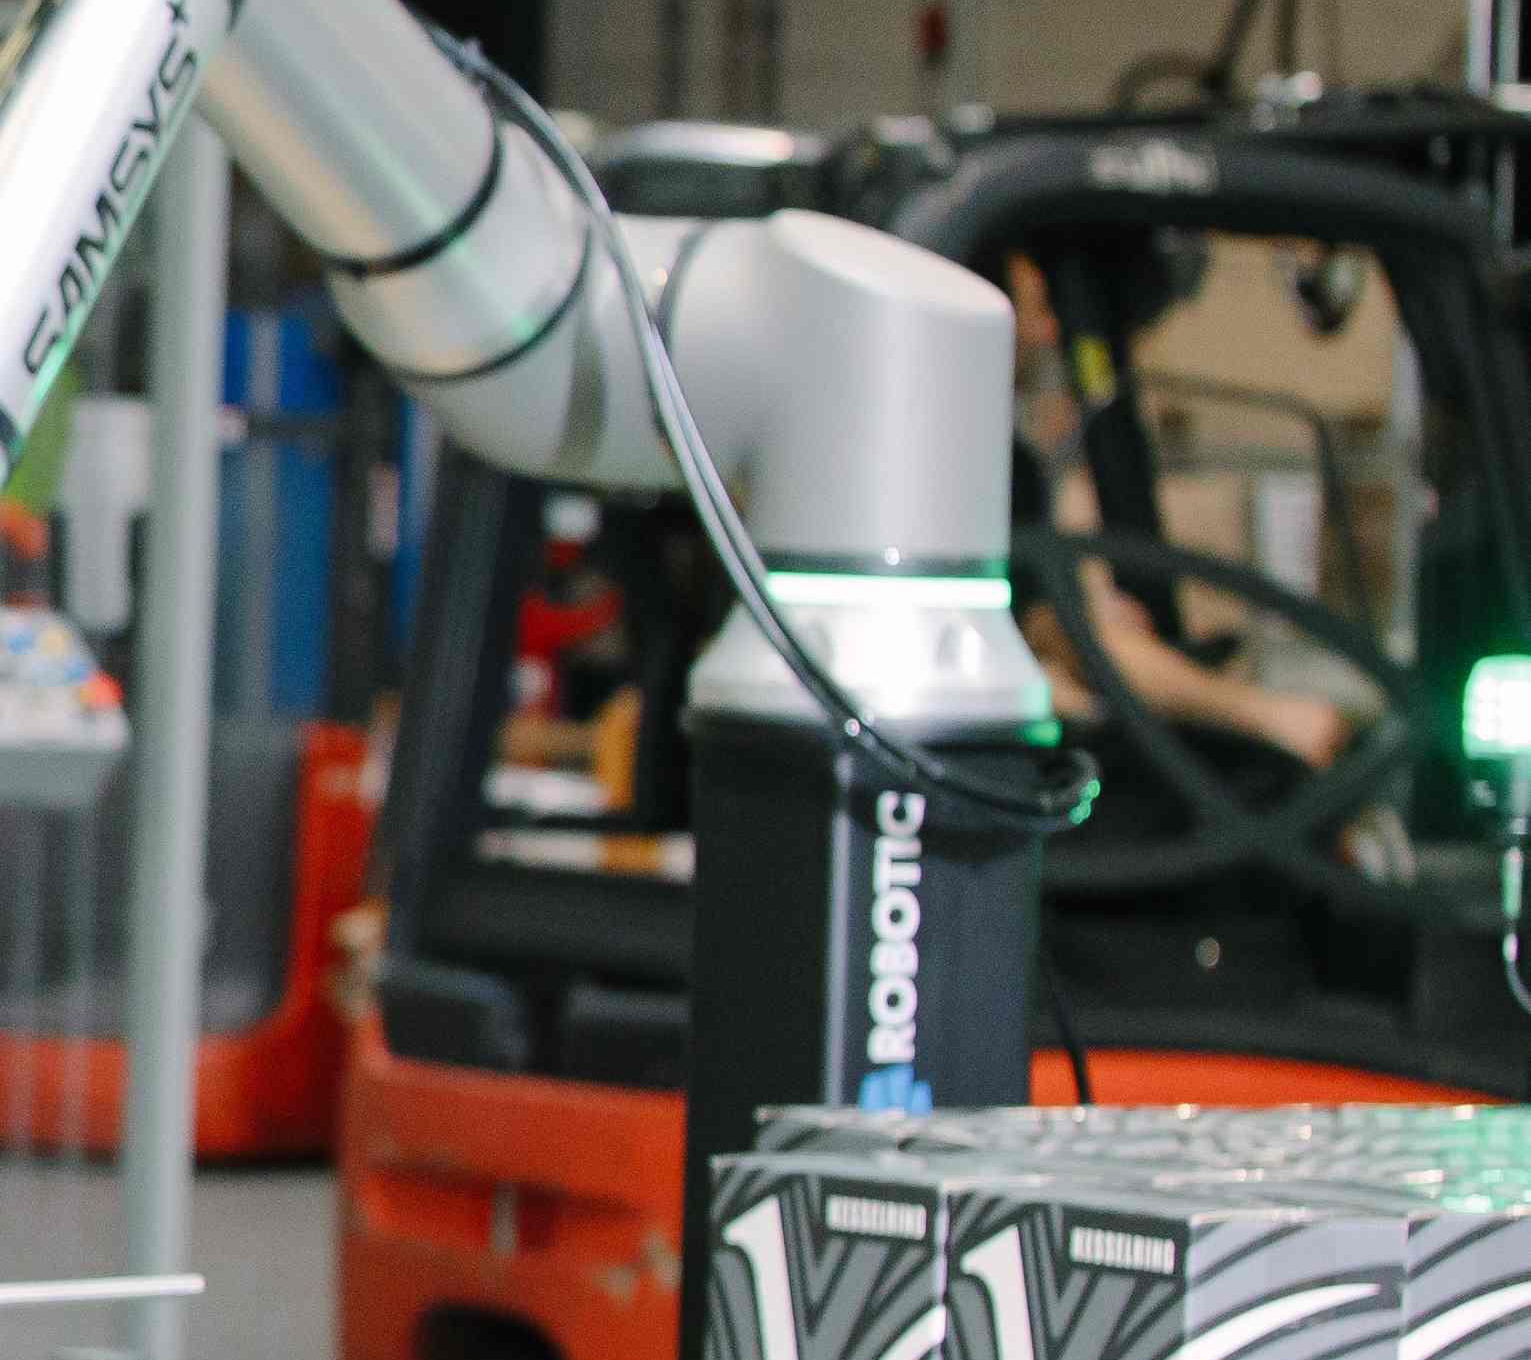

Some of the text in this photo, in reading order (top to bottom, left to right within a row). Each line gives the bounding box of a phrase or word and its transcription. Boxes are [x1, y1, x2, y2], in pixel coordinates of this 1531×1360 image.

[23, 33, 198, 378] SAMSYS
[867, 790, 926, 1064] ROBOTIC
[1070, 1225, 1176, 1275] KESSELRING
